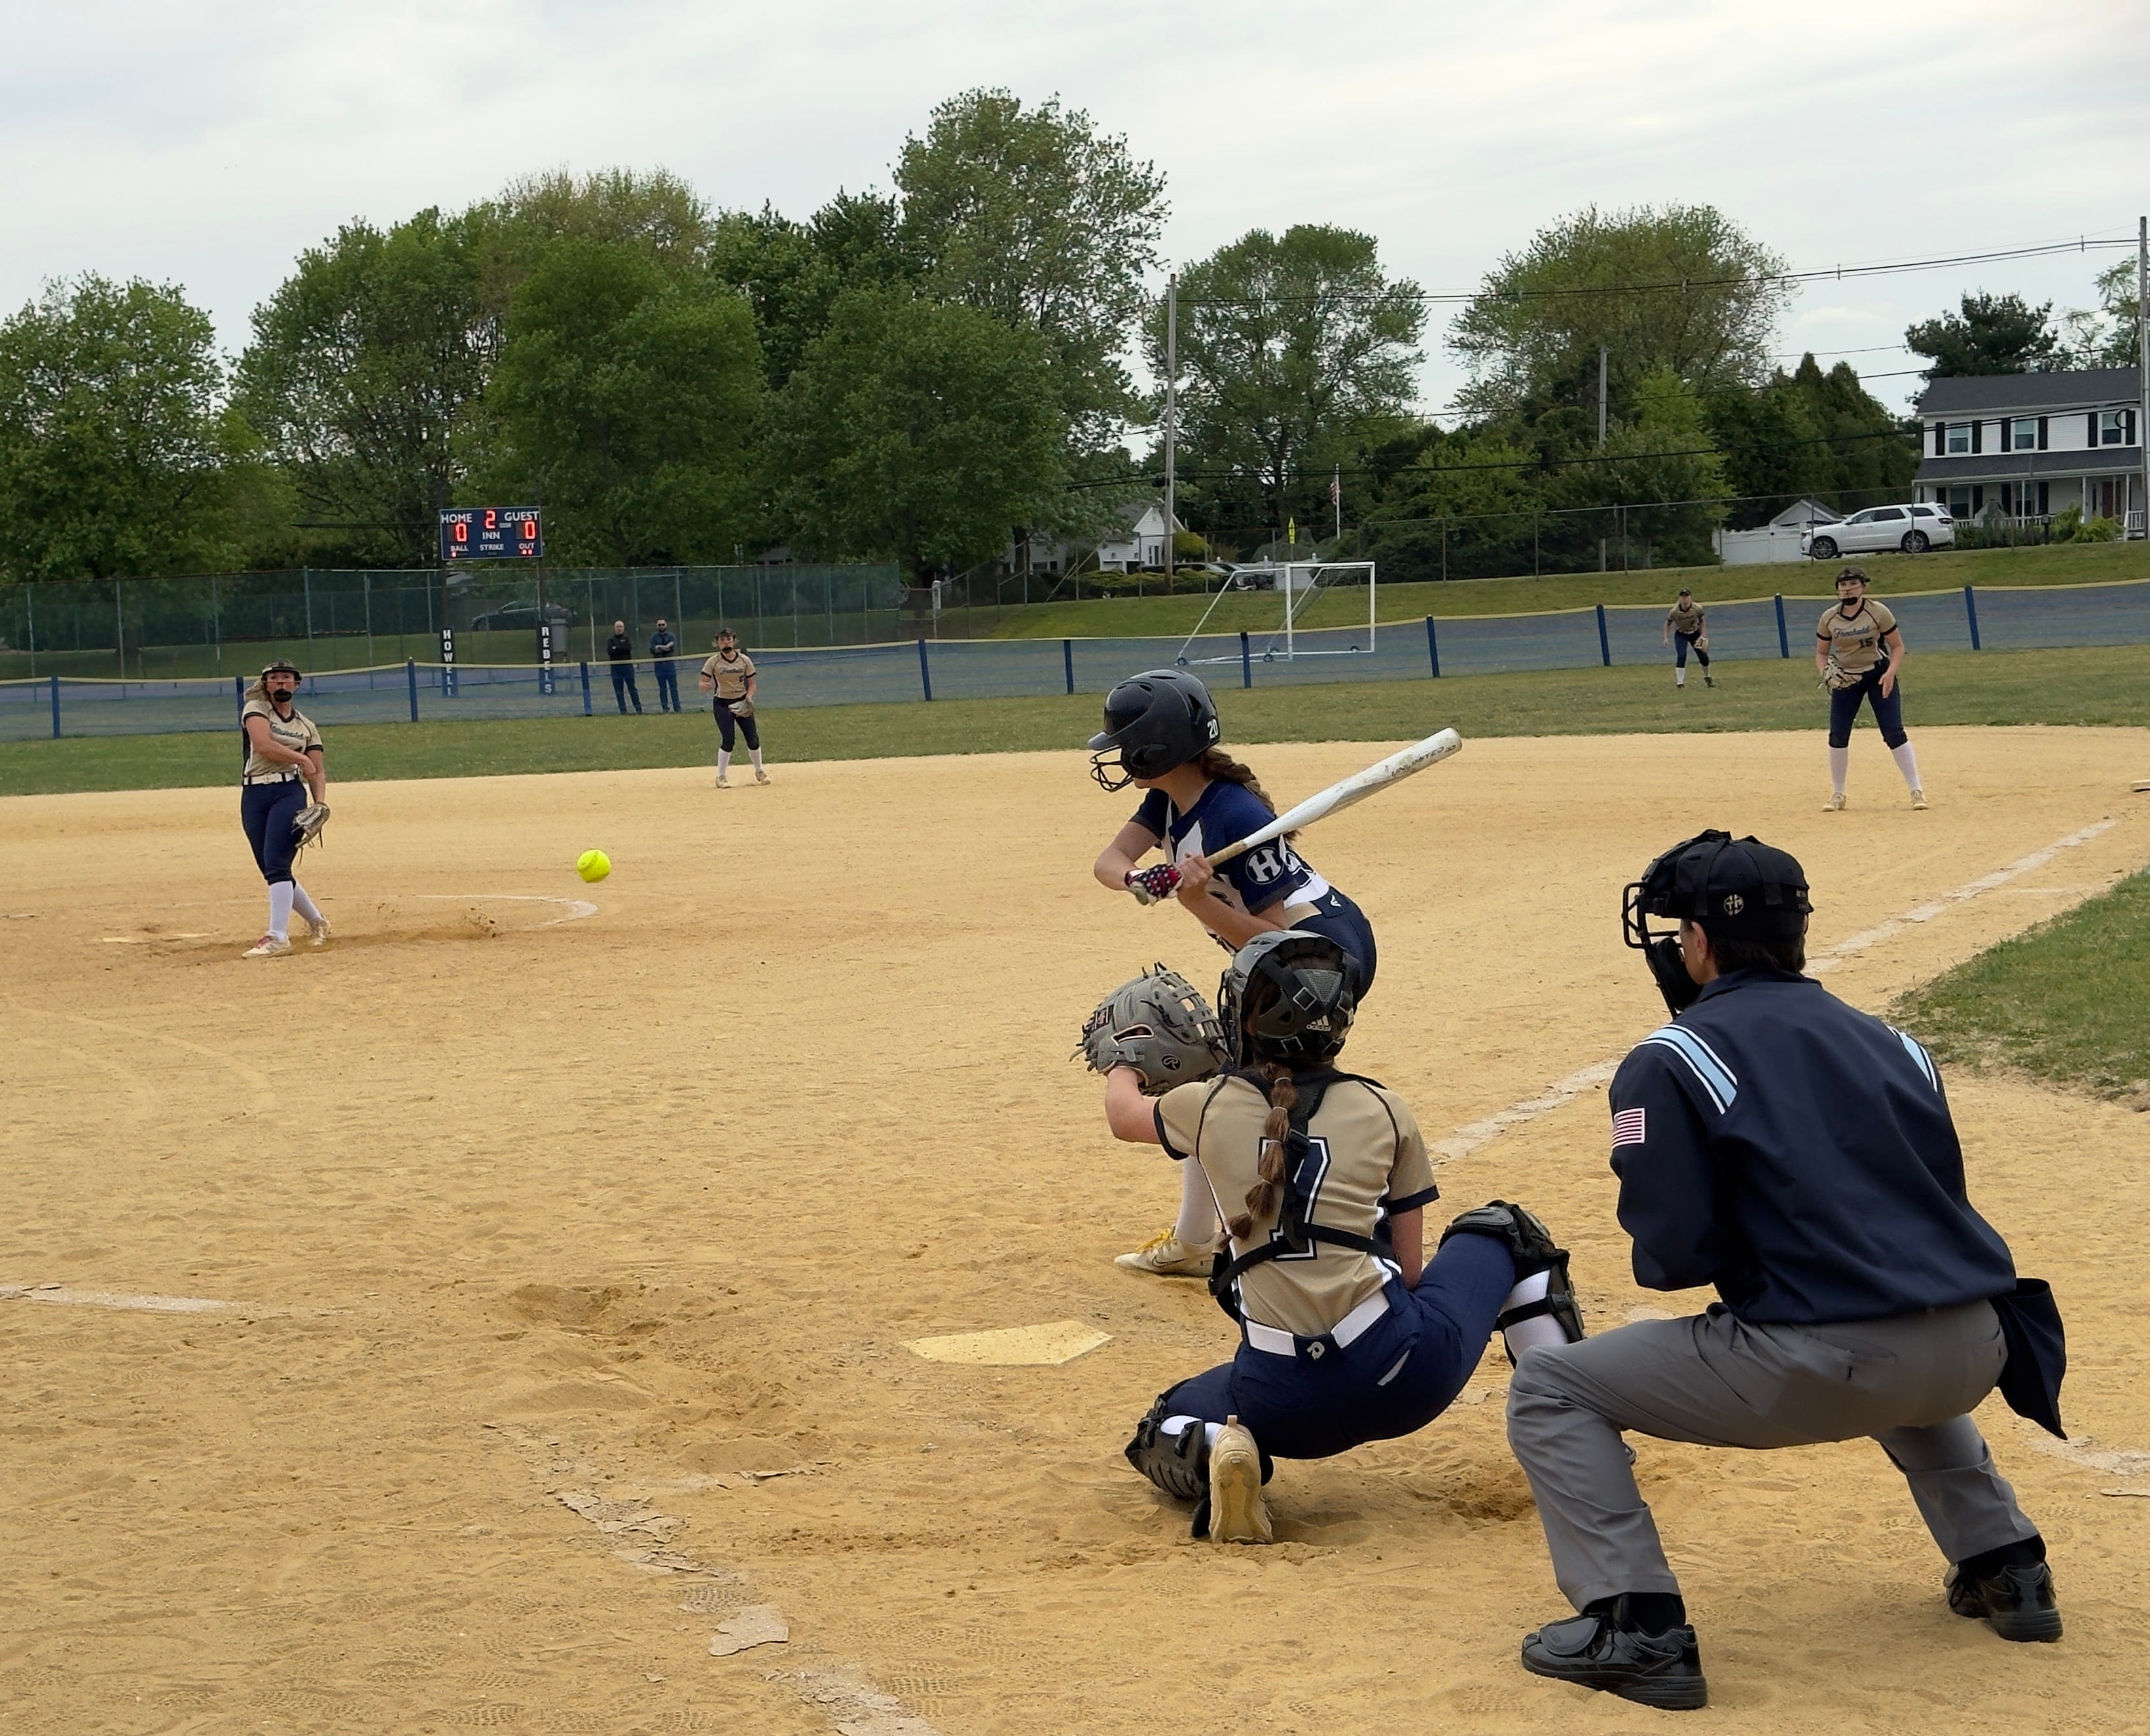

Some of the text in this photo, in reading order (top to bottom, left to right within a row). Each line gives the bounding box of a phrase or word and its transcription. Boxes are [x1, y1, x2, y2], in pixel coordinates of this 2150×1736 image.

[441, 513, 473, 523] HOME
[486, 510, 495, 529] 2
[505, 511, 539, 522] GUEST
[456, 523, 467, 542] 0
[482, 531, 501, 540] INN
[524, 521, 535, 539] 0
[1859, 637, 1874, 648] 15
[442, 629, 454, 697] HOWELL
[541, 626, 552, 694] REBELS
[1207, 718, 1219, 739] 20
[1391, 746, 1444, 777] UNLIMITED
[1248, 849, 1282, 883] H
[1306, 1023, 1333, 1032] adidas
[1258, 1137, 1332, 1262] 7
